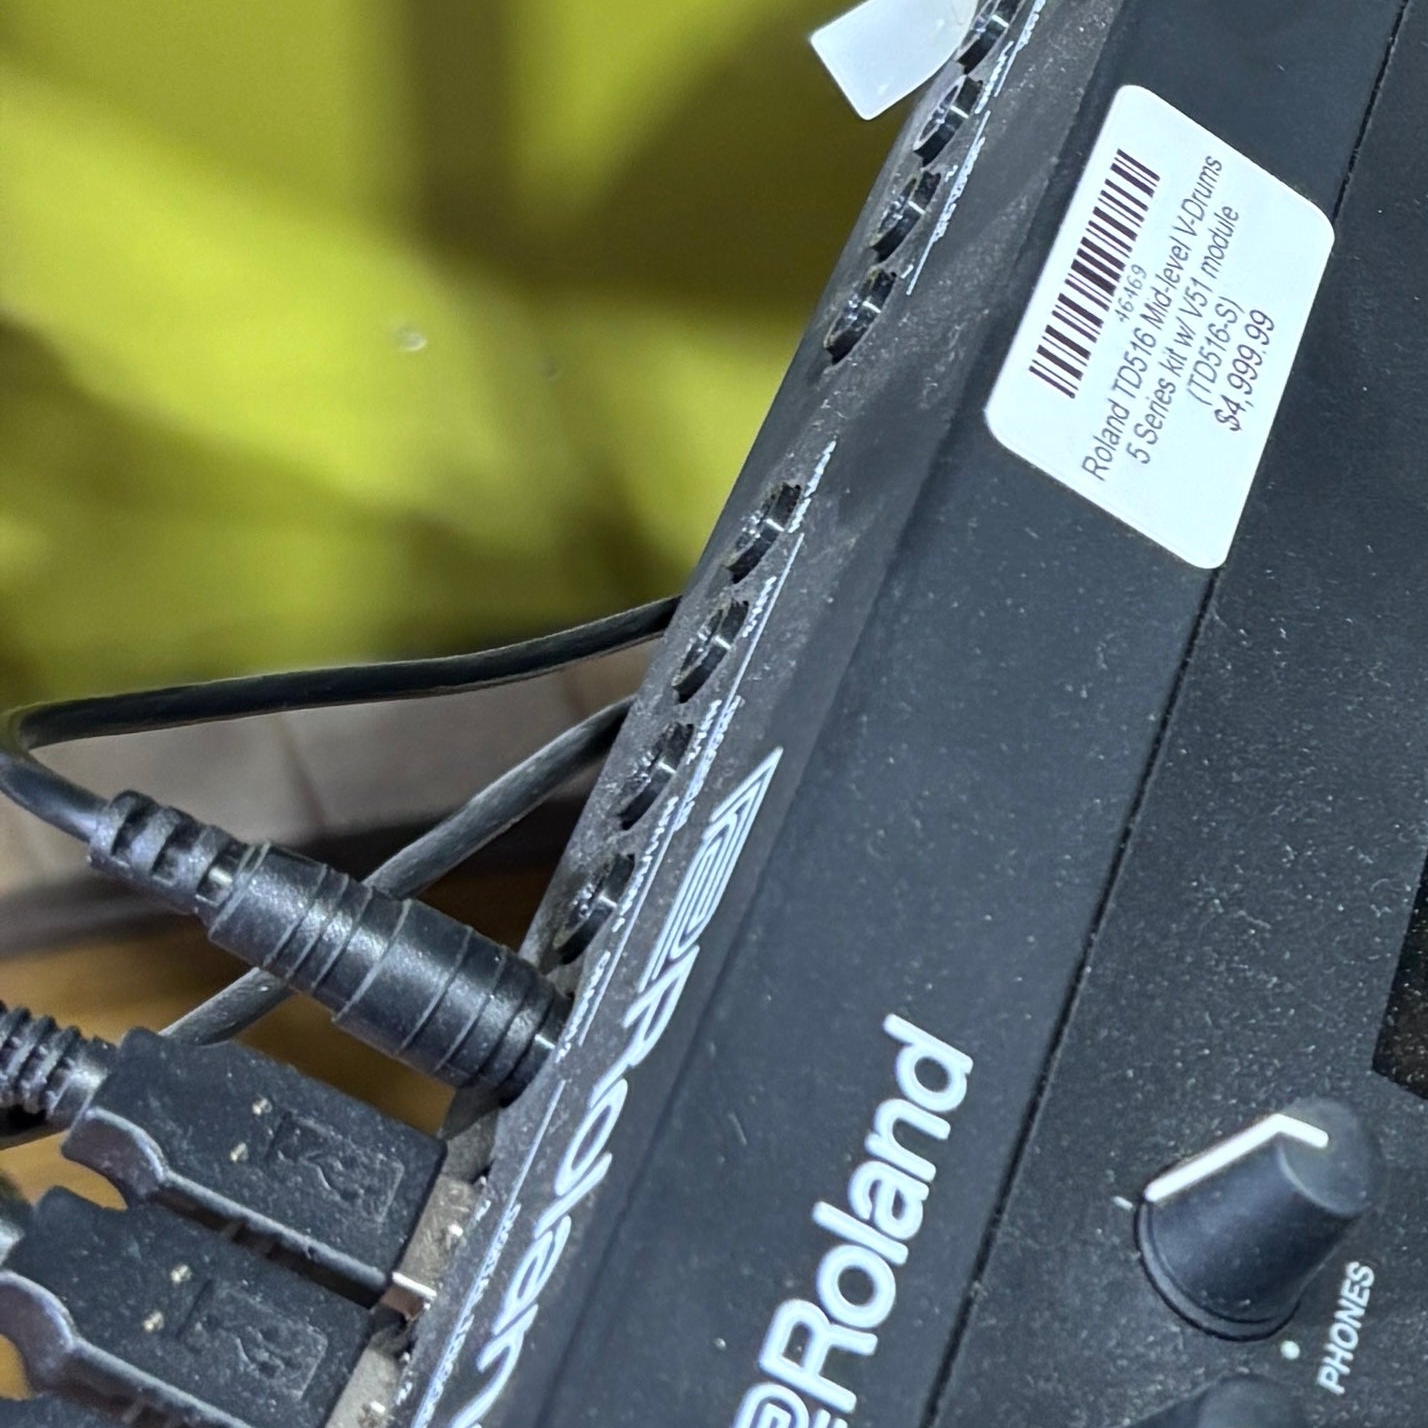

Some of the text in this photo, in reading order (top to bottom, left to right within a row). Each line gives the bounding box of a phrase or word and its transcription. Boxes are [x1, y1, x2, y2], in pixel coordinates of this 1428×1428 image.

[1081, 155, 1223, 481] Roland TD516 Mid-level V-Drums
[1126, 205, 1240, 465] 5 Series kit w/ V51 module
[1186, 296, 1245, 406] (TD516-S)
[1214, 309, 1275, 432] $4,999.99
[759, 1013, 974, 1415] Roland
[1317, 1260, 1375, 1396] PHONES
